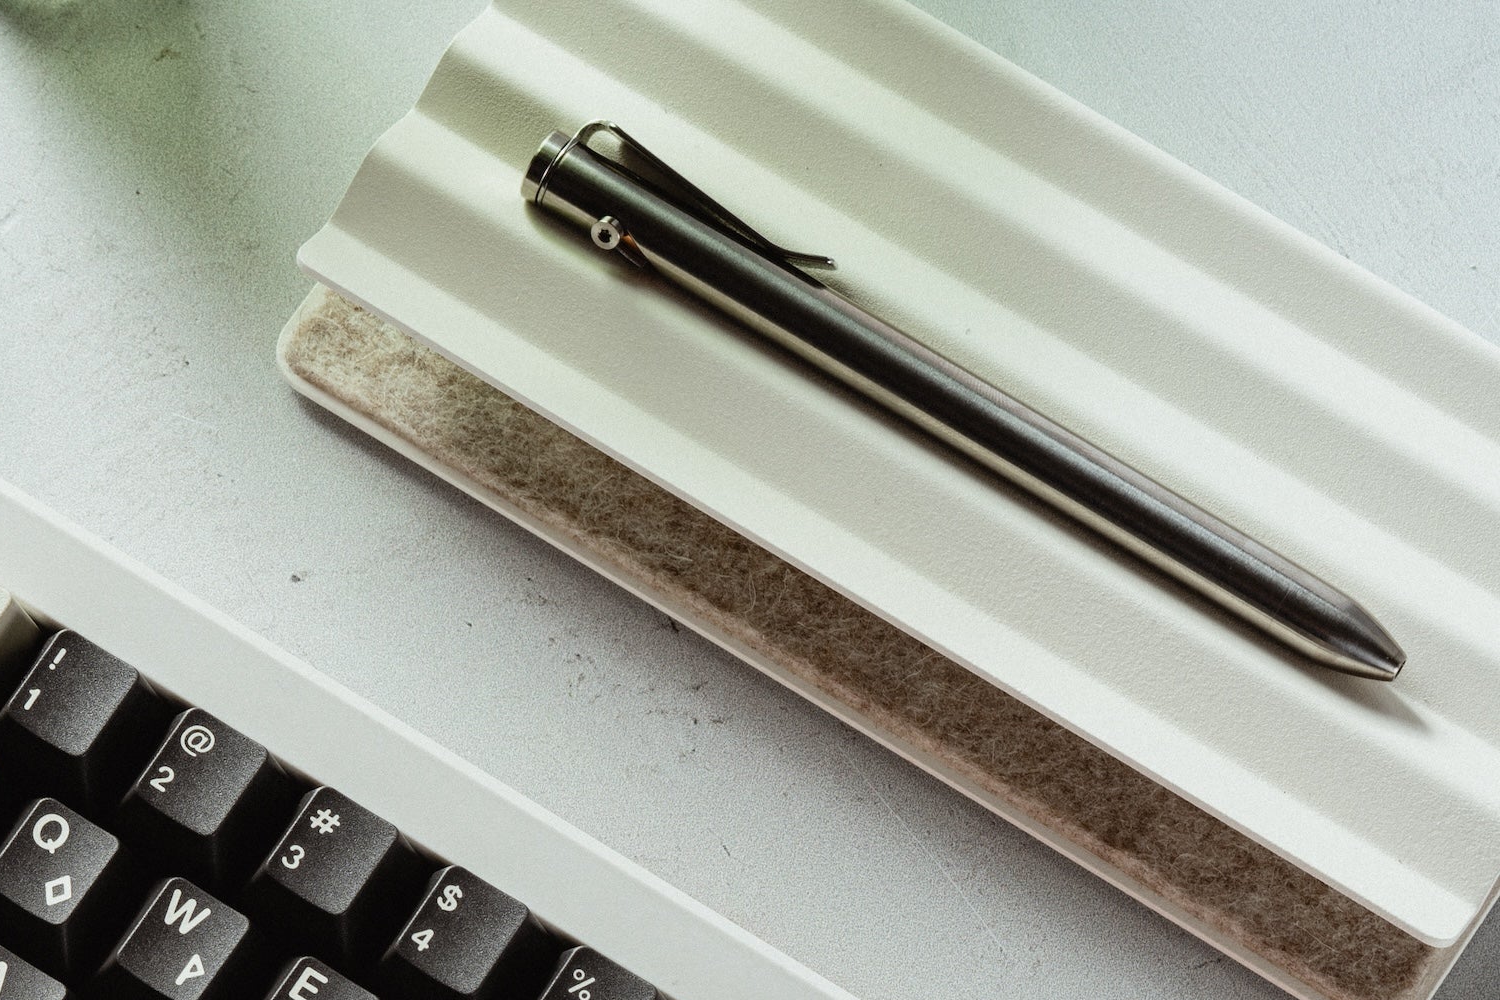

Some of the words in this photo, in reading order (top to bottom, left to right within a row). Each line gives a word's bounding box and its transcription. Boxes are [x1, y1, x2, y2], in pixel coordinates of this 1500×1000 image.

[23, 688, 41, 711] 1
[149, 766, 175, 793] 2
[32, 813, 70, 855] Q
[281, 844, 305, 870] 3
[164, 888, 212, 935] W
[411, 929, 435, 952] 4
